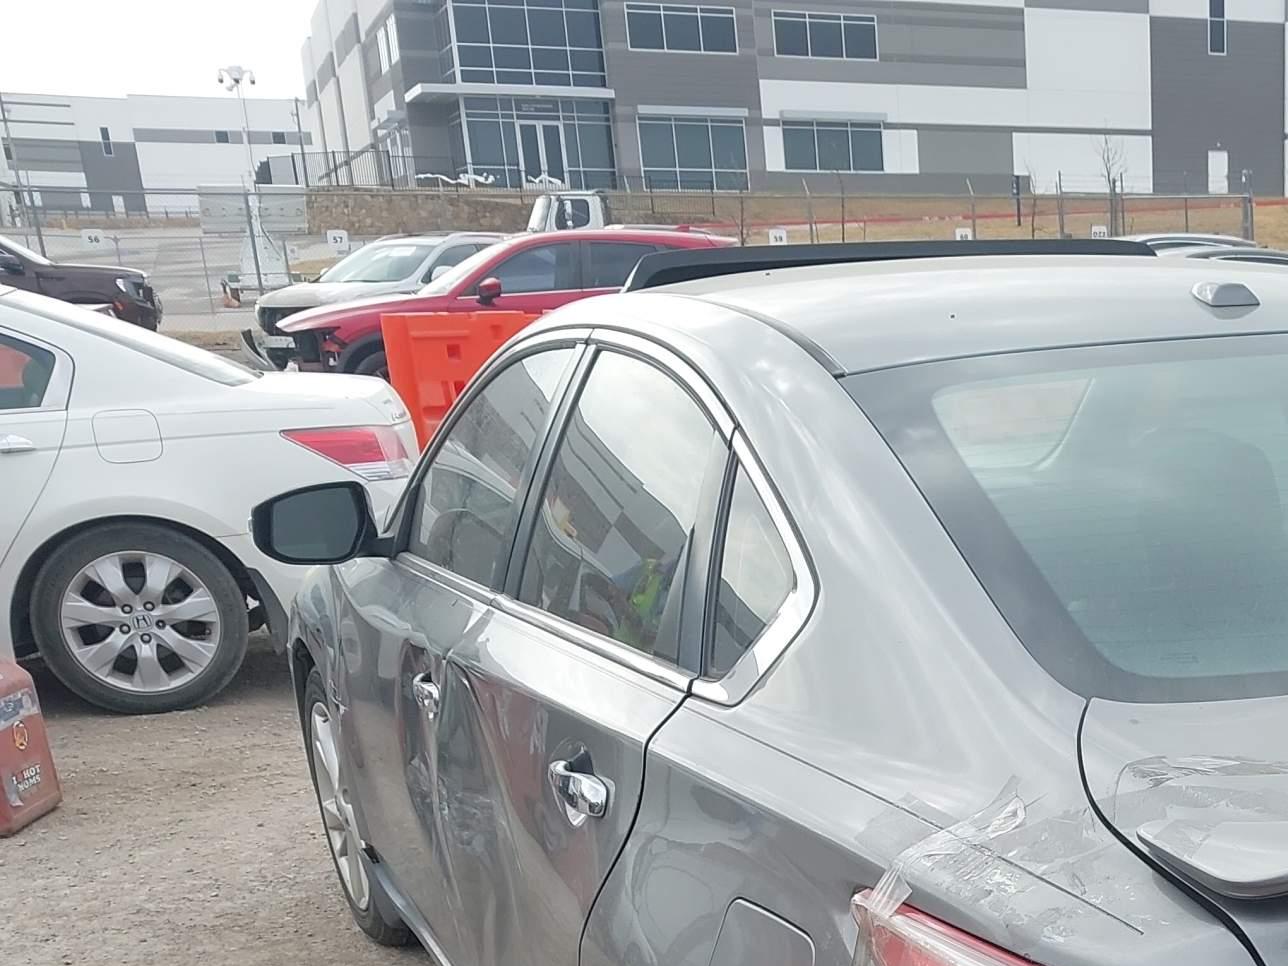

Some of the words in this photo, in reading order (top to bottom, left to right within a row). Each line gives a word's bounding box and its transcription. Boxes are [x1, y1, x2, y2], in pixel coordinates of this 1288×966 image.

[87, 234, 100, 243] 56
[332, 235, 343, 244] 57
[22, 764, 41, 779] HOT
